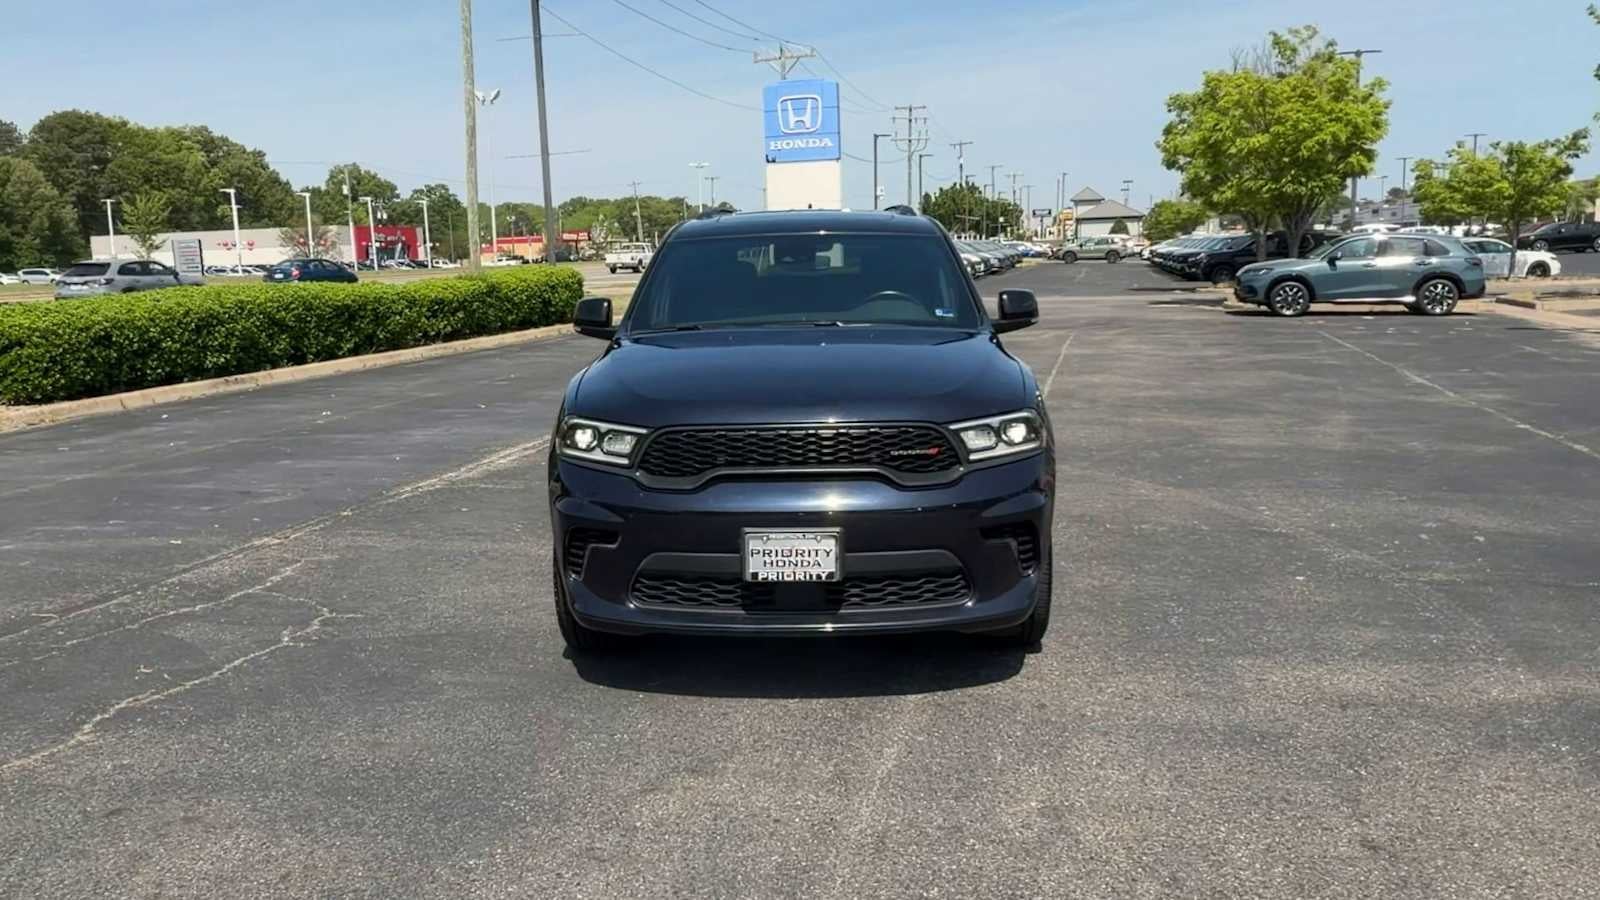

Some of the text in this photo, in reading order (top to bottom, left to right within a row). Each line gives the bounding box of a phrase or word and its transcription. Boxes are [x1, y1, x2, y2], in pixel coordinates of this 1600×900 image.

[769, 138, 834, 150] HONDA
[750, 548, 833, 558] PRIORITY
[763, 559, 823, 568] HONDA
[758, 571, 829, 581] PRIORITY
